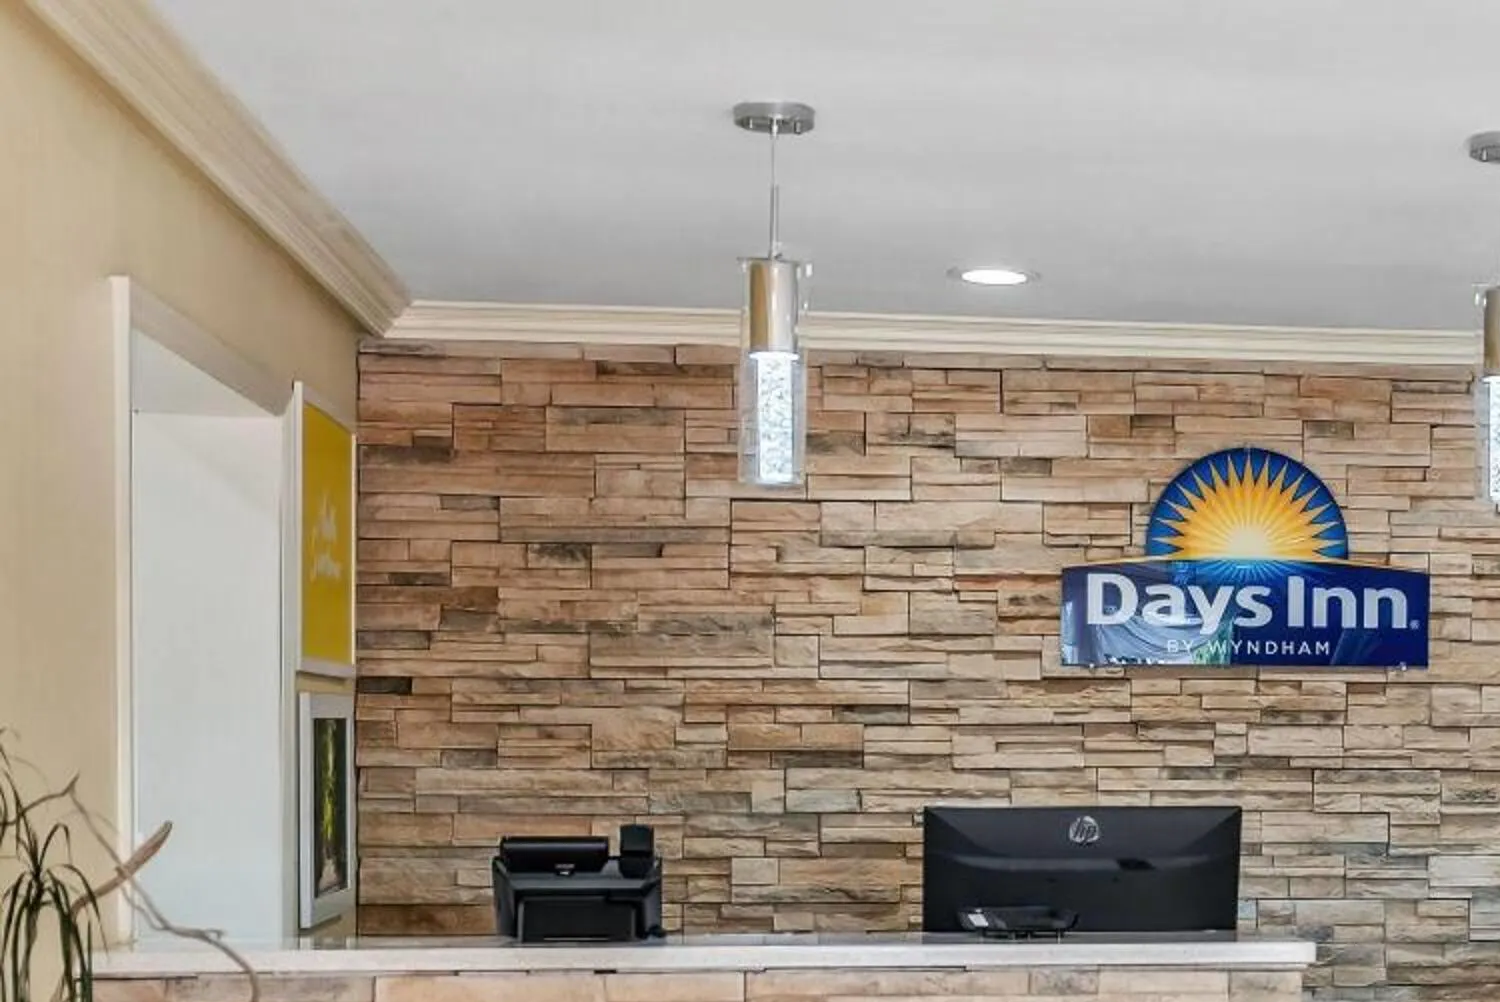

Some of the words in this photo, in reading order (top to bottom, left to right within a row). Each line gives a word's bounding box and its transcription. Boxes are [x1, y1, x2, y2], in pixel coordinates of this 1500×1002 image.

[1086, 573, 1273, 635] Days
[1287, 576, 1409, 630] Inn
[1167, 640, 1193, 653] BY
[1208, 640, 1330, 655] WYNDHAM
